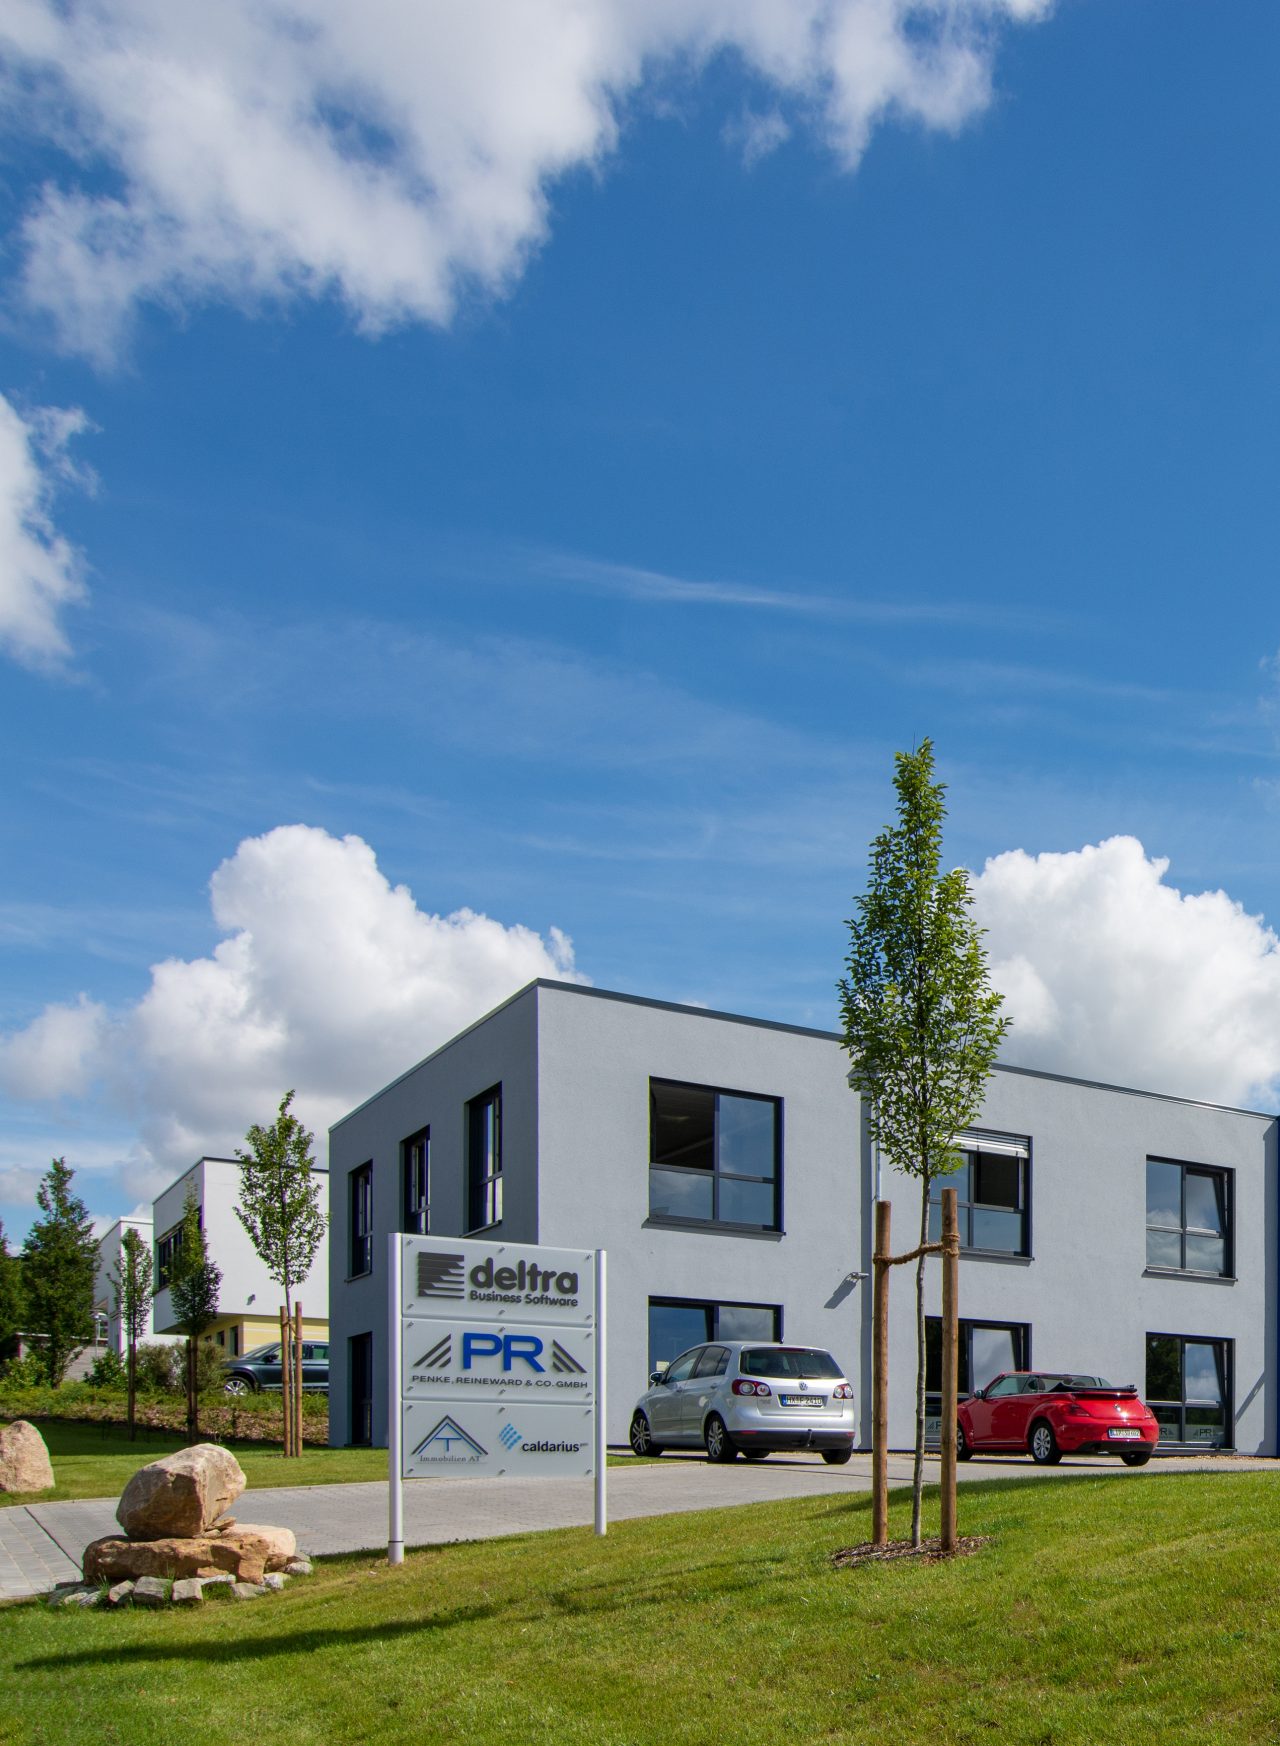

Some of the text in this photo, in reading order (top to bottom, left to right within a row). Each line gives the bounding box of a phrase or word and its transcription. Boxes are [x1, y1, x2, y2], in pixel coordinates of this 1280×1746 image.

[470, 1257, 578, 1294] deltra
[470, 1290, 578, 1307] Business Software
[463, 1332, 546, 1373] PR
[412, 1375, 454, 1384] PENKE,
[456, 1376, 522, 1386] REINEWARD
[525, 1379, 533, 1387] &
[522, 1440, 580, 1452] caldarius
